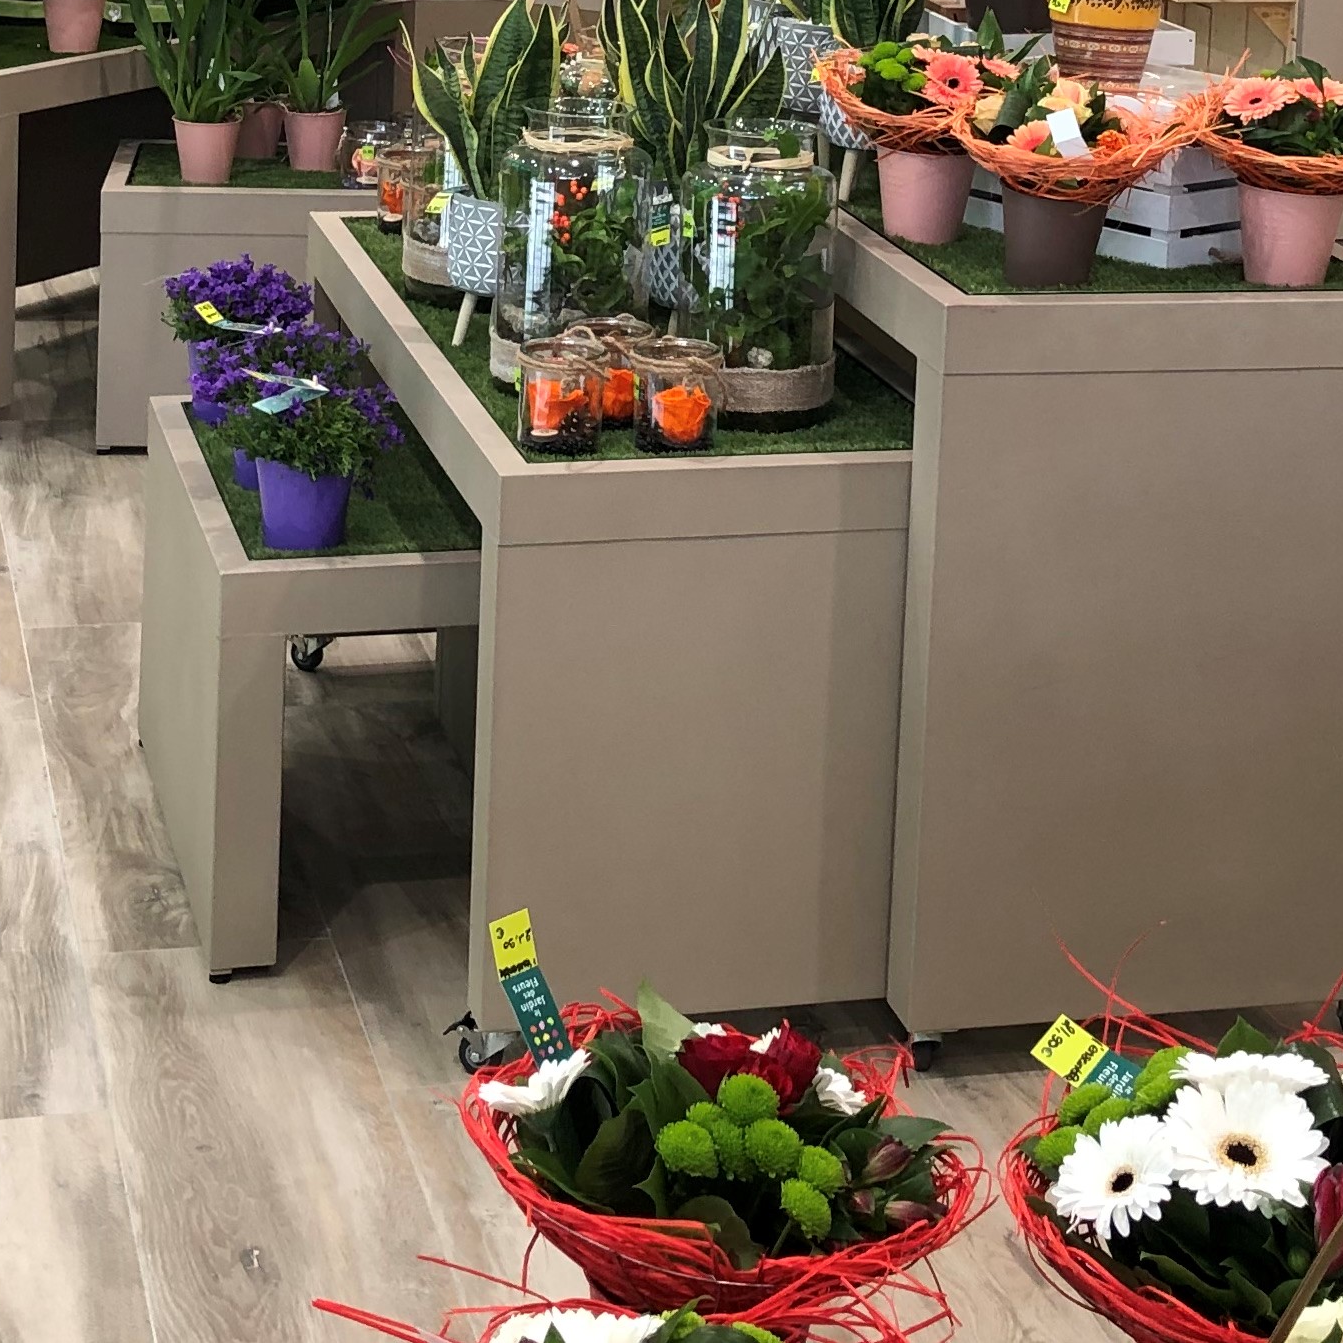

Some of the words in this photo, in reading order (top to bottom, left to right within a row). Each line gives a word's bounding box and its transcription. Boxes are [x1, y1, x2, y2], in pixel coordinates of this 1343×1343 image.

[511, 976, 540, 994] Fleurs
[522, 989, 536, 999] des
[520, 994, 546, 1012] Jardin
[1096, 1060, 1119, 1086] Fleur
[1124, 1086, 1134, 1095] le
